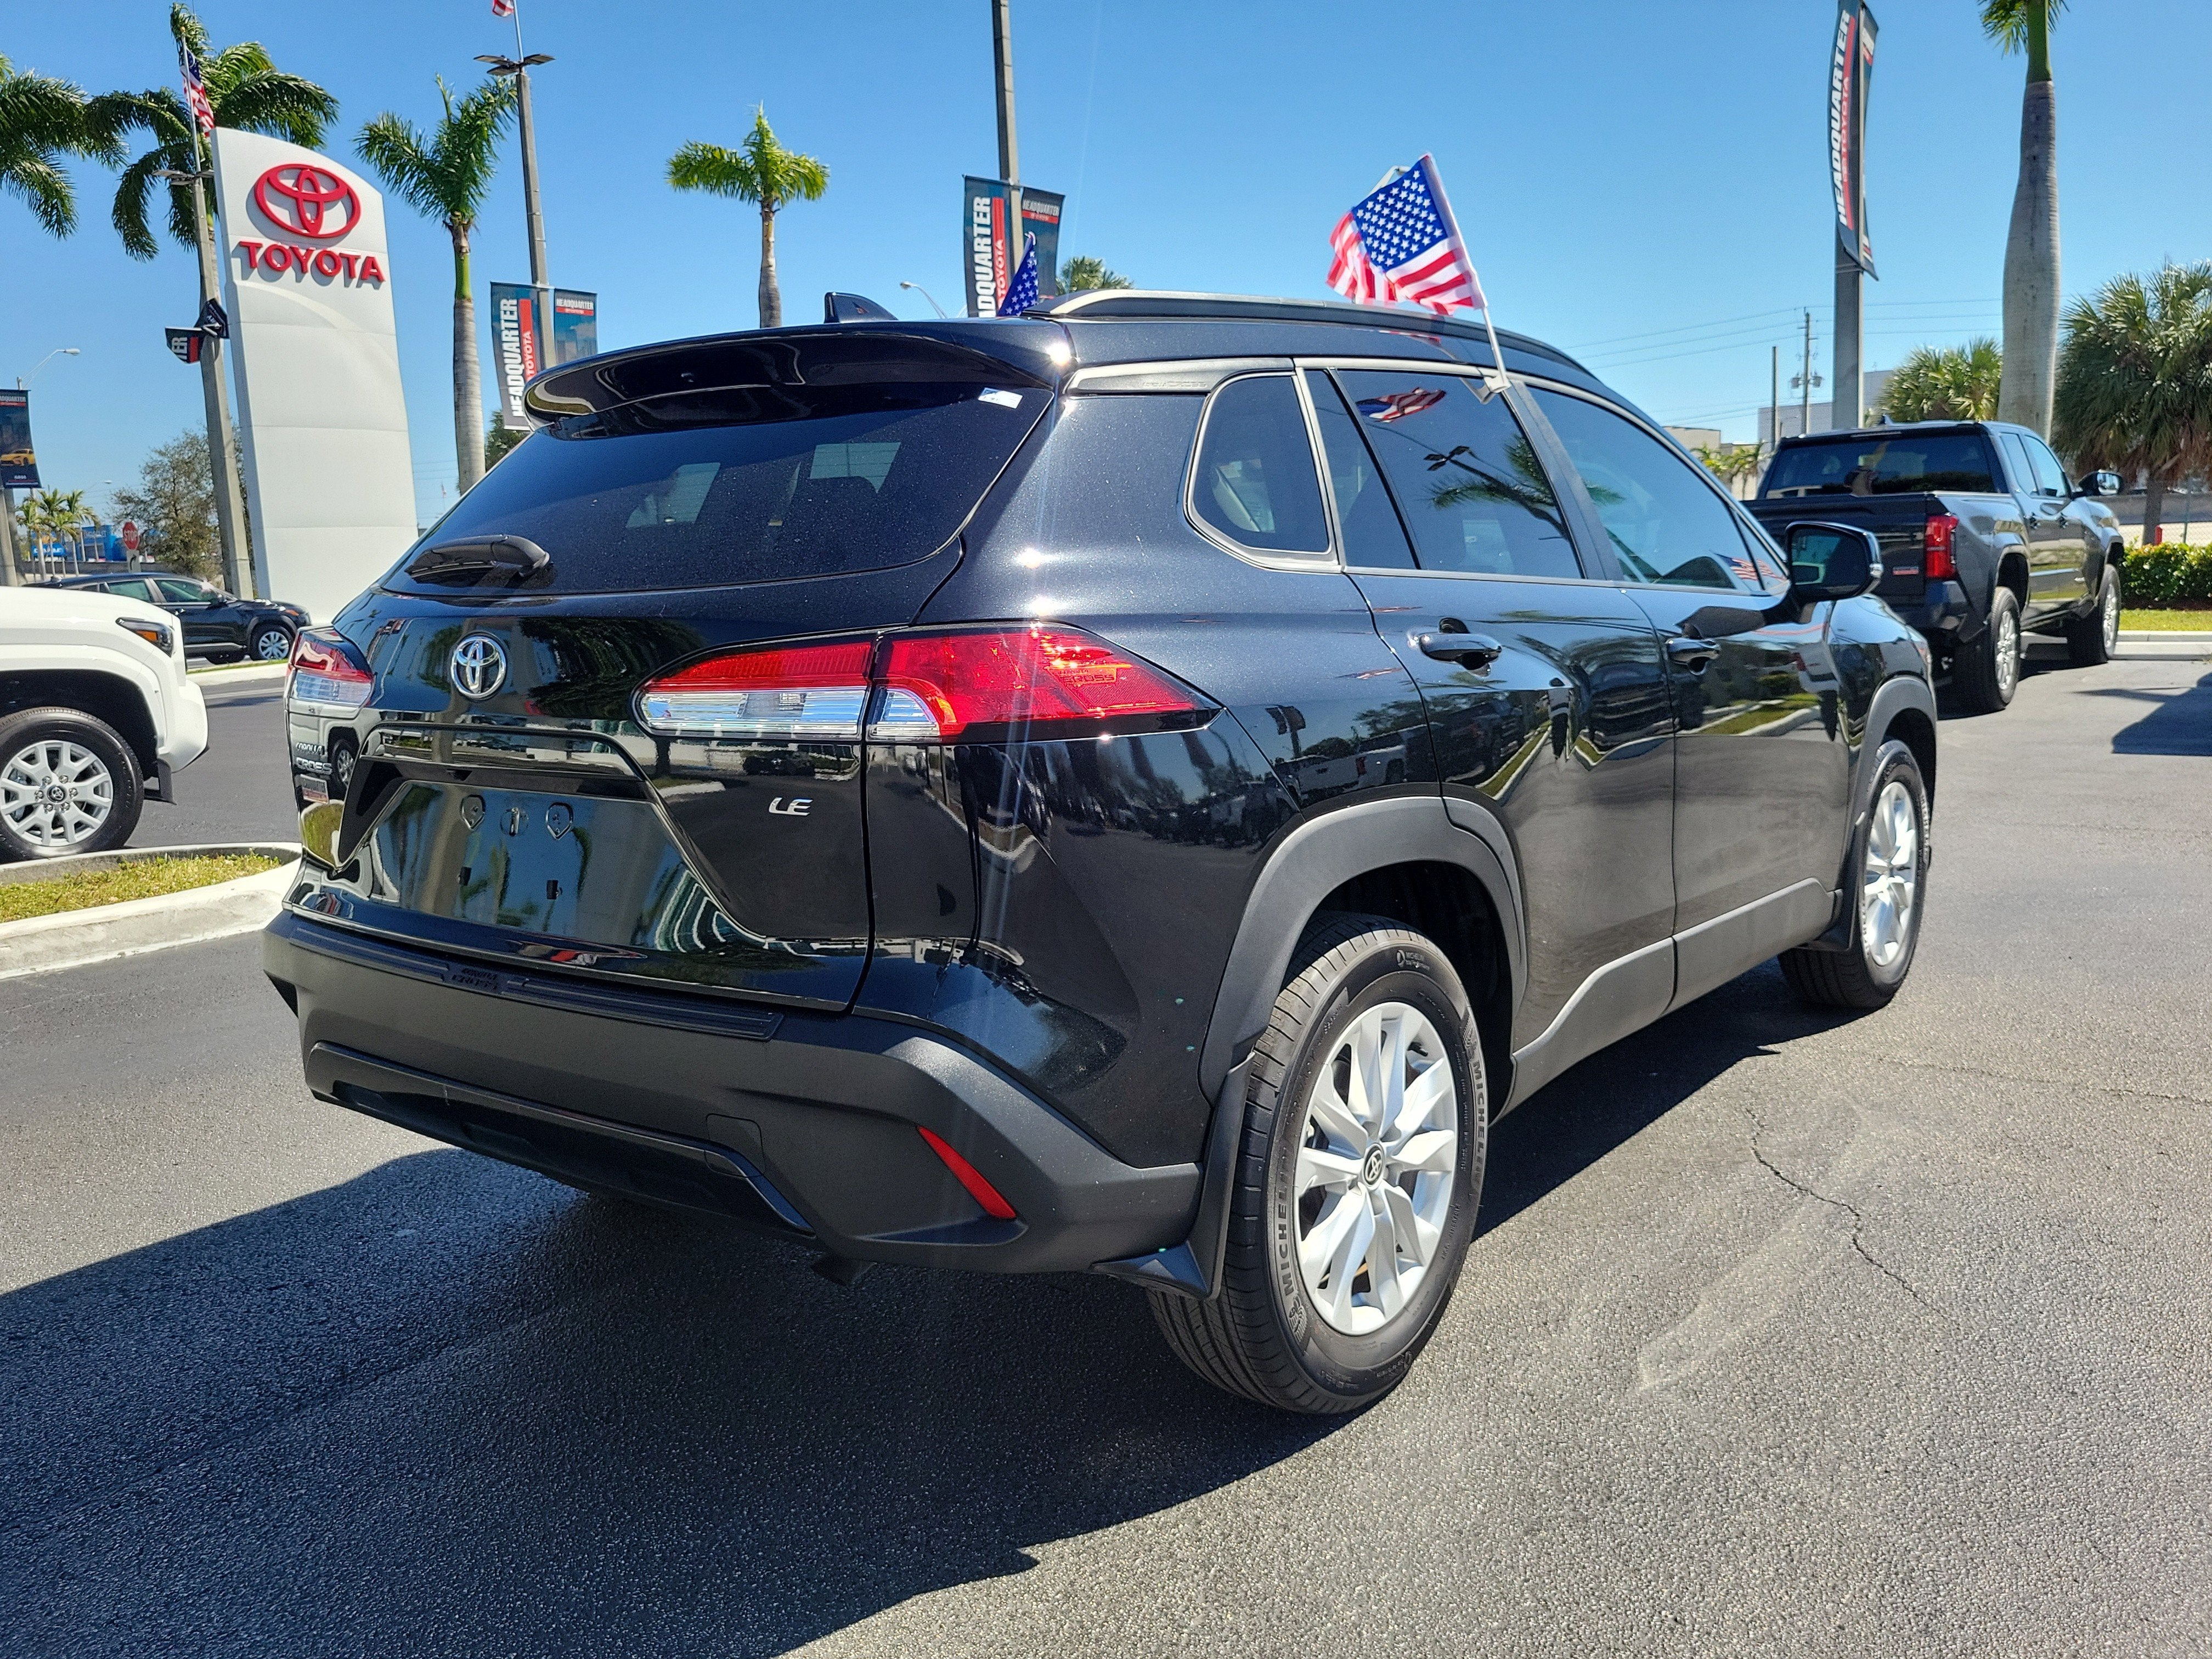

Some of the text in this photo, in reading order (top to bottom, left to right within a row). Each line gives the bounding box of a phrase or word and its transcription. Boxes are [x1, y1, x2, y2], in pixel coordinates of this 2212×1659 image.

[1831, 9, 1850, 225] HEADQUARTER
[239, 241, 385, 282] TOYOTA
[995, 239, 1007, 297] TOYOTA
[557, 298, 594, 310] HEADQUARTER
[500, 298, 525, 417] HEADQUARTER
[523, 330, 536, 375] TOYOTA
[124, 530, 138, 541] STOP
[769, 797, 813, 816] LE
[1472, 1060, 1485, 1183] MICHELIN
